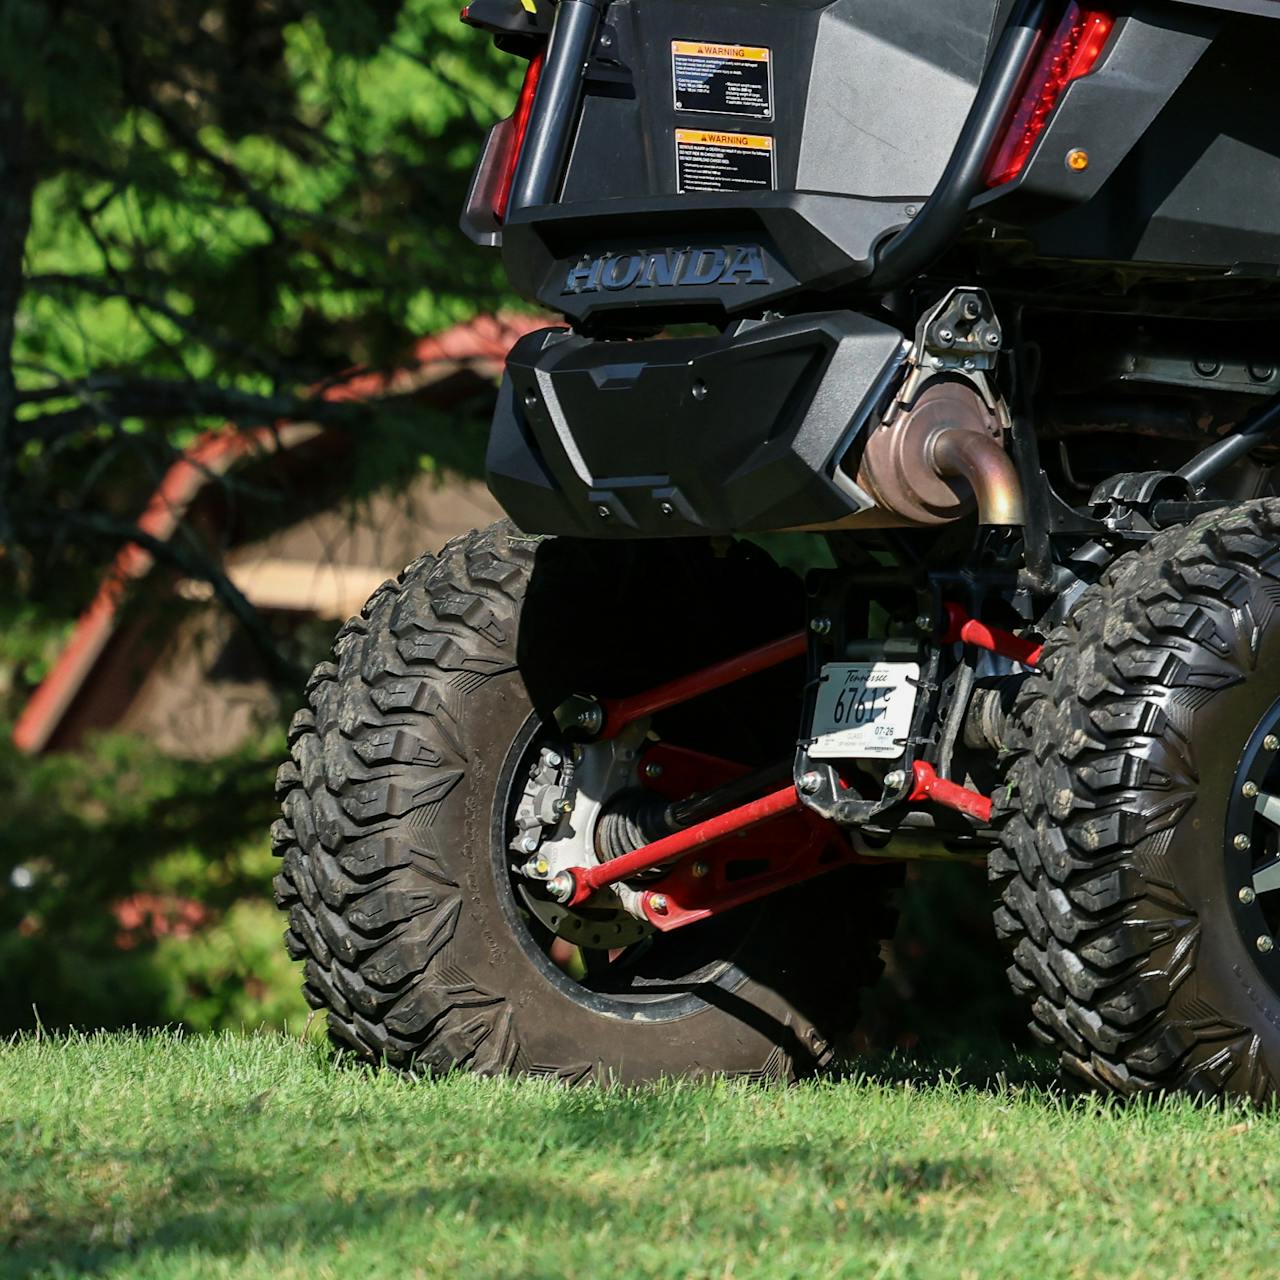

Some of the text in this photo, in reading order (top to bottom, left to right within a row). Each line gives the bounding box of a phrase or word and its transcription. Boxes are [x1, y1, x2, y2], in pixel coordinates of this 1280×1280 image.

[705, 46, 745, 57] WARNING
[708, 134, 748, 145] WARNING
[560, 246, 773, 296] HONDA
[845, 670, 888, 685] Tennessee
[834, 687, 878, 723] 6761
